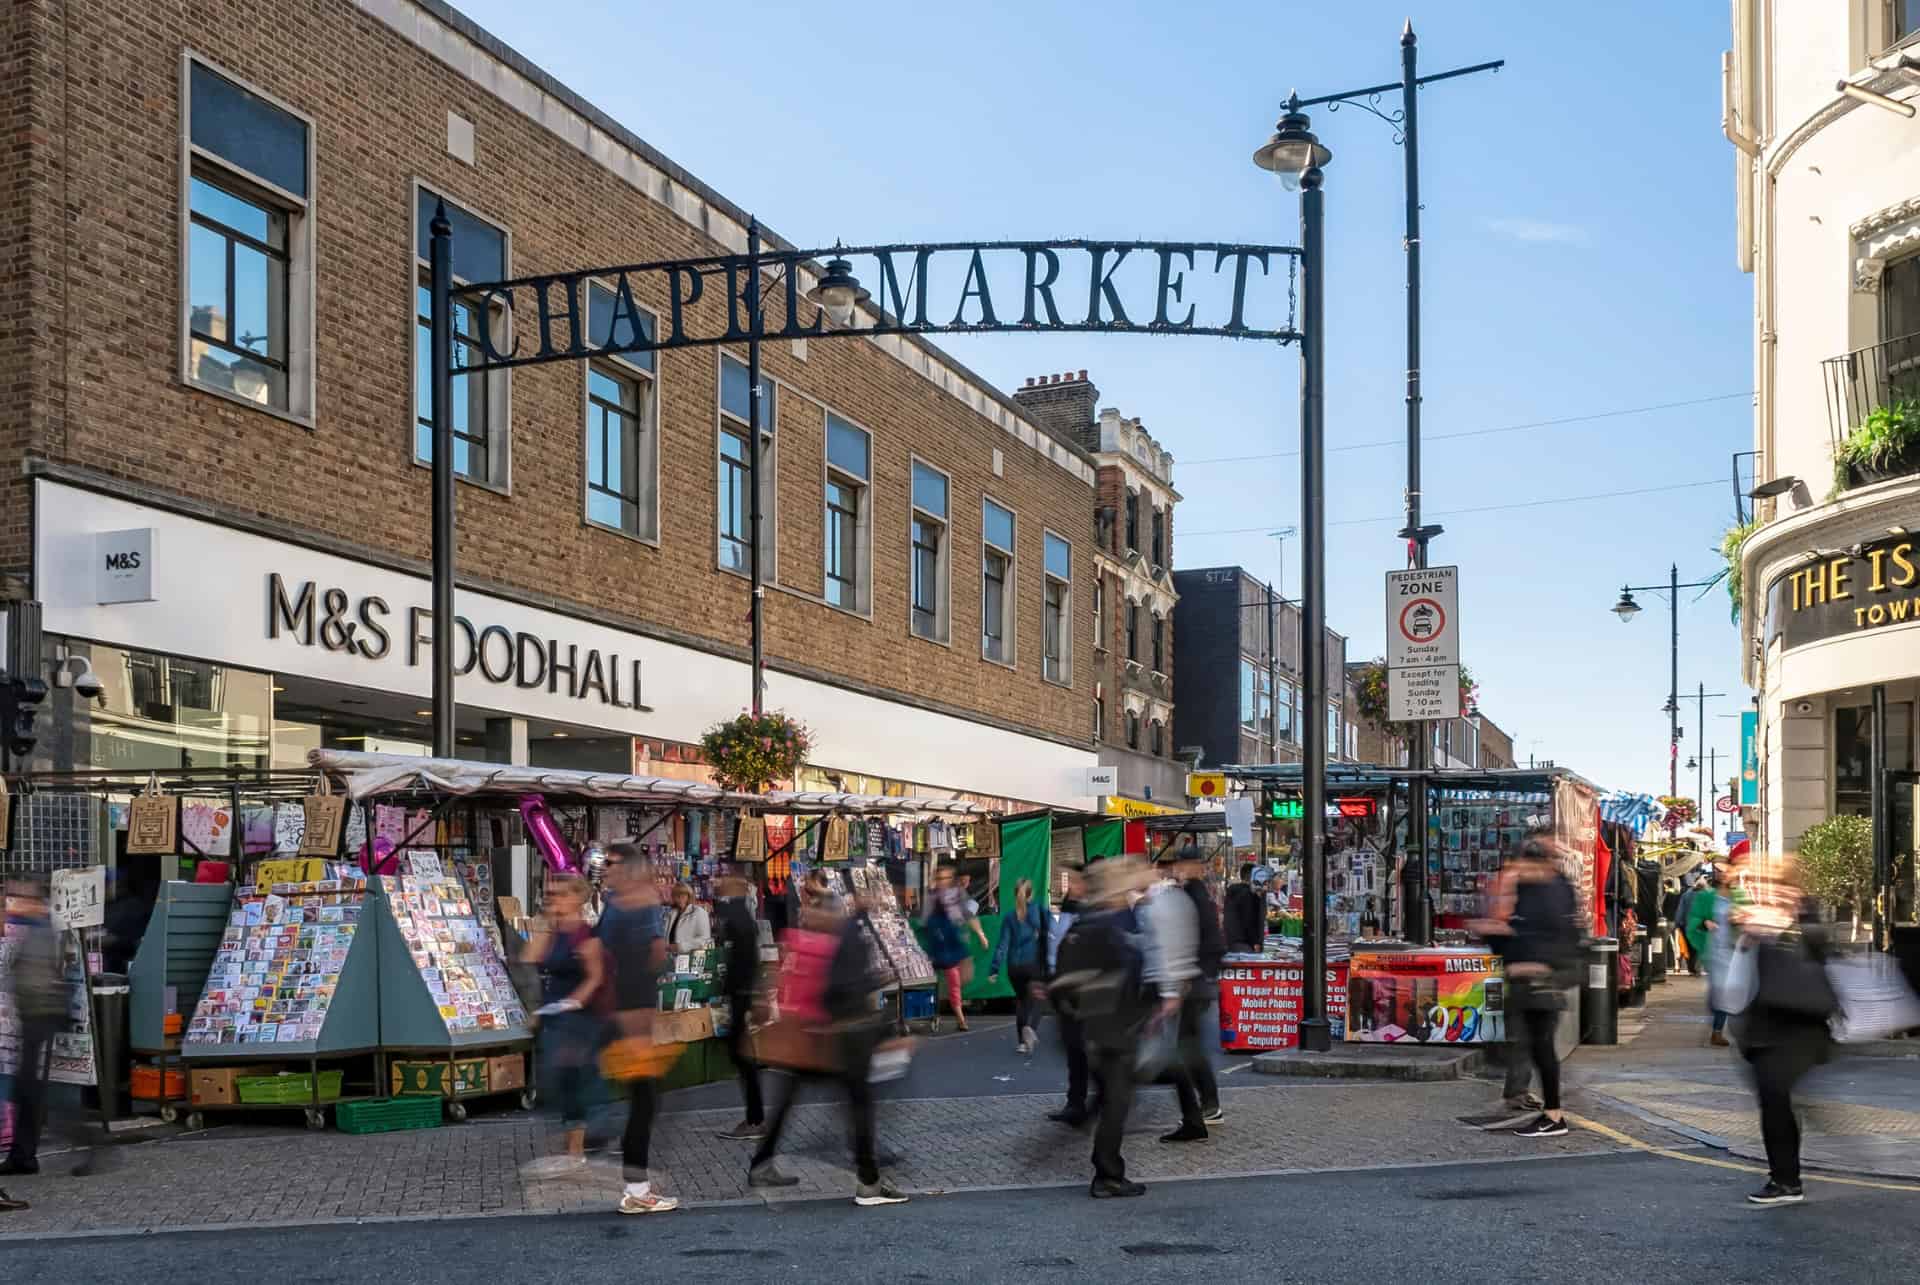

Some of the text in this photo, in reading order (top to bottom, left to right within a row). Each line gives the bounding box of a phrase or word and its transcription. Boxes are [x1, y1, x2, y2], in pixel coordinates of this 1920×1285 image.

[478, 246, 1269, 361] CHAPEL MARKET
[105, 551, 141, 571] M&S
[1391, 570, 1452, 582] PEDESTRIAN
[1400, 581, 1443, 595] ZONE
[1788, 557, 1849, 611] THE
[269, 572, 654, 711] M&S FOODHALL
[1407, 646, 1440, 654] Sunday
[1400, 669, 1446, 678] Except for
[1407, 688, 1441, 697] Sunday
[1427, 709, 1441, 717] pm
[1444, 958, 1488, 973] ANGEL
[1233, 986, 1246, 996] We
[1247, 986, 1272, 997] Repair
[1273, 986, 1289, 996] And
[1242, 998, 1297, 1009] Mobile Phones
[1238, 1010, 1299, 1021] All Accessories
[1238, 1023, 1298, 1034] For Phones And
[1247, 1035, 1288, 1046] Computers
